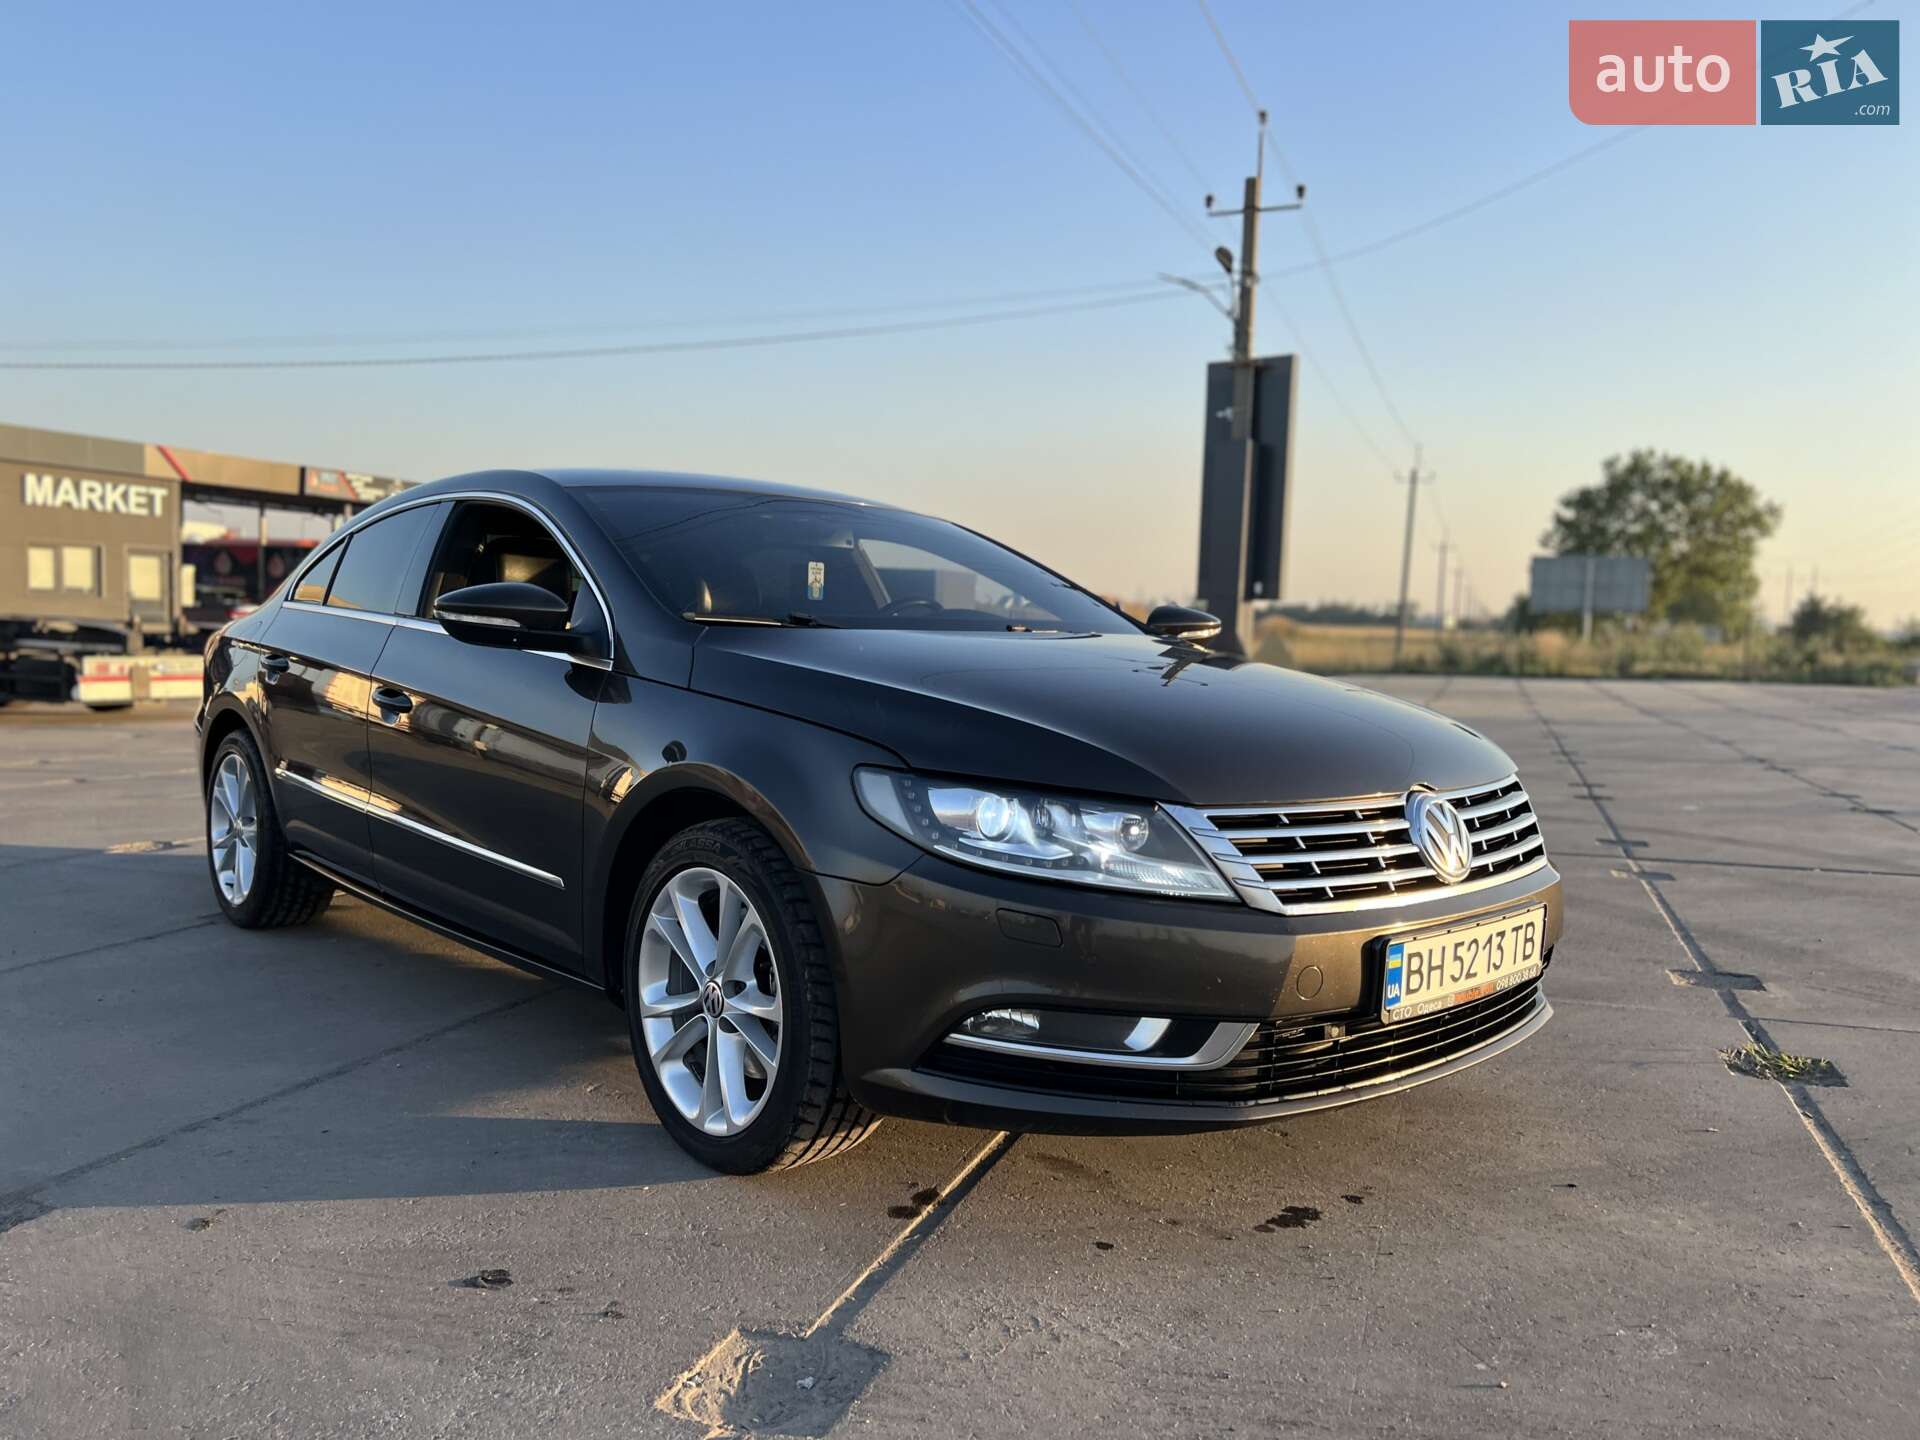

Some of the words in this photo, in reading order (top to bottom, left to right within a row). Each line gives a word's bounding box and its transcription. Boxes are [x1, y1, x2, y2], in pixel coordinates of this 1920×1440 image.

[23, 472, 168, 518] MARKET
[1405, 945, 1446, 996] BH
[1449, 929, 1506, 983] 5213
[1511, 921, 1536, 965] TB
[1387, 983, 1400, 998] UA
